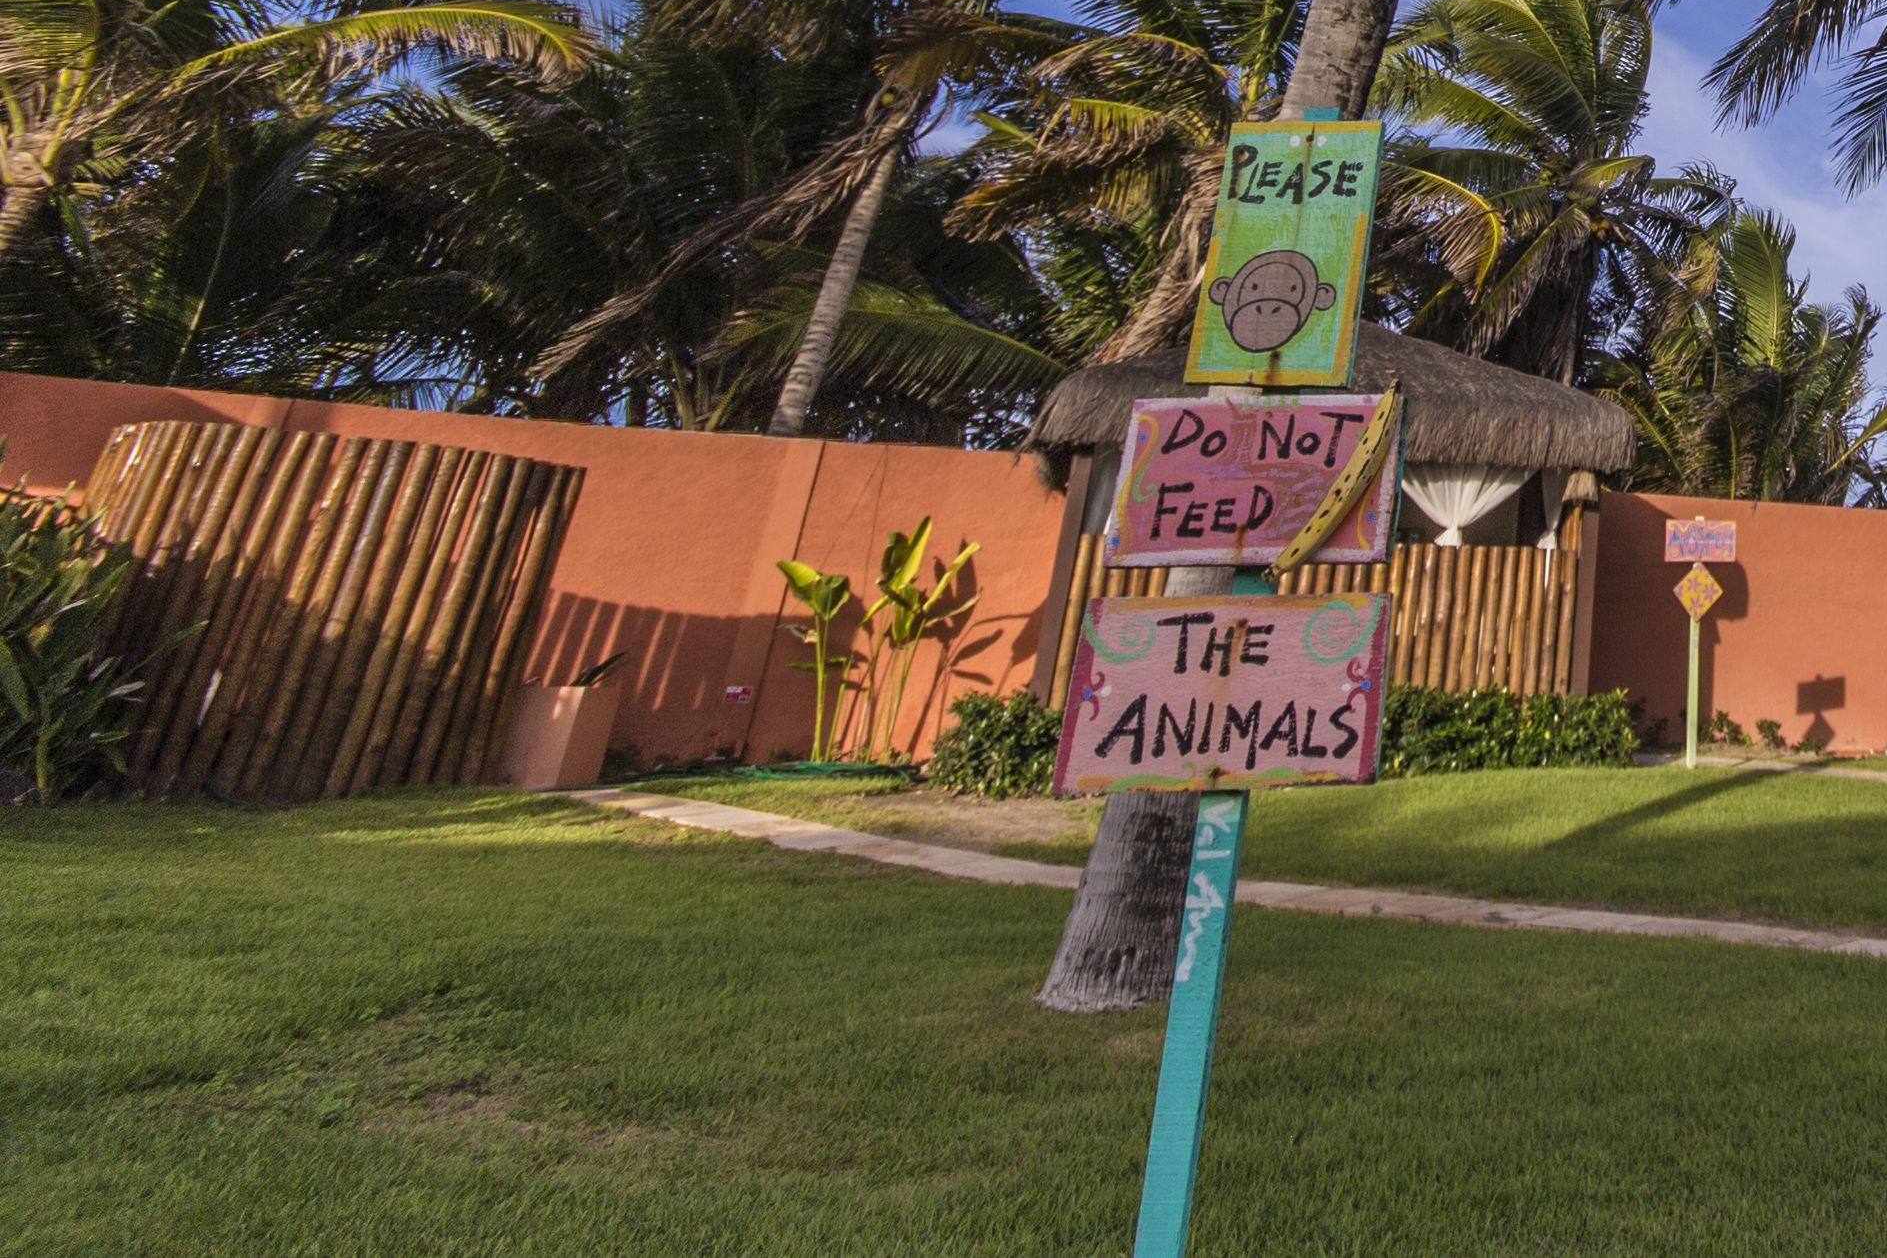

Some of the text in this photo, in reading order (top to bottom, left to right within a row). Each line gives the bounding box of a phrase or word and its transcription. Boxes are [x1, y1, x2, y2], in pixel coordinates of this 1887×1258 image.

[1228, 144, 1364, 205] PLEASE
[1149, 481, 1275, 541] FEED
[1156, 611, 1276, 677] THE
[1094, 693, 1360, 771] ANIMALS
